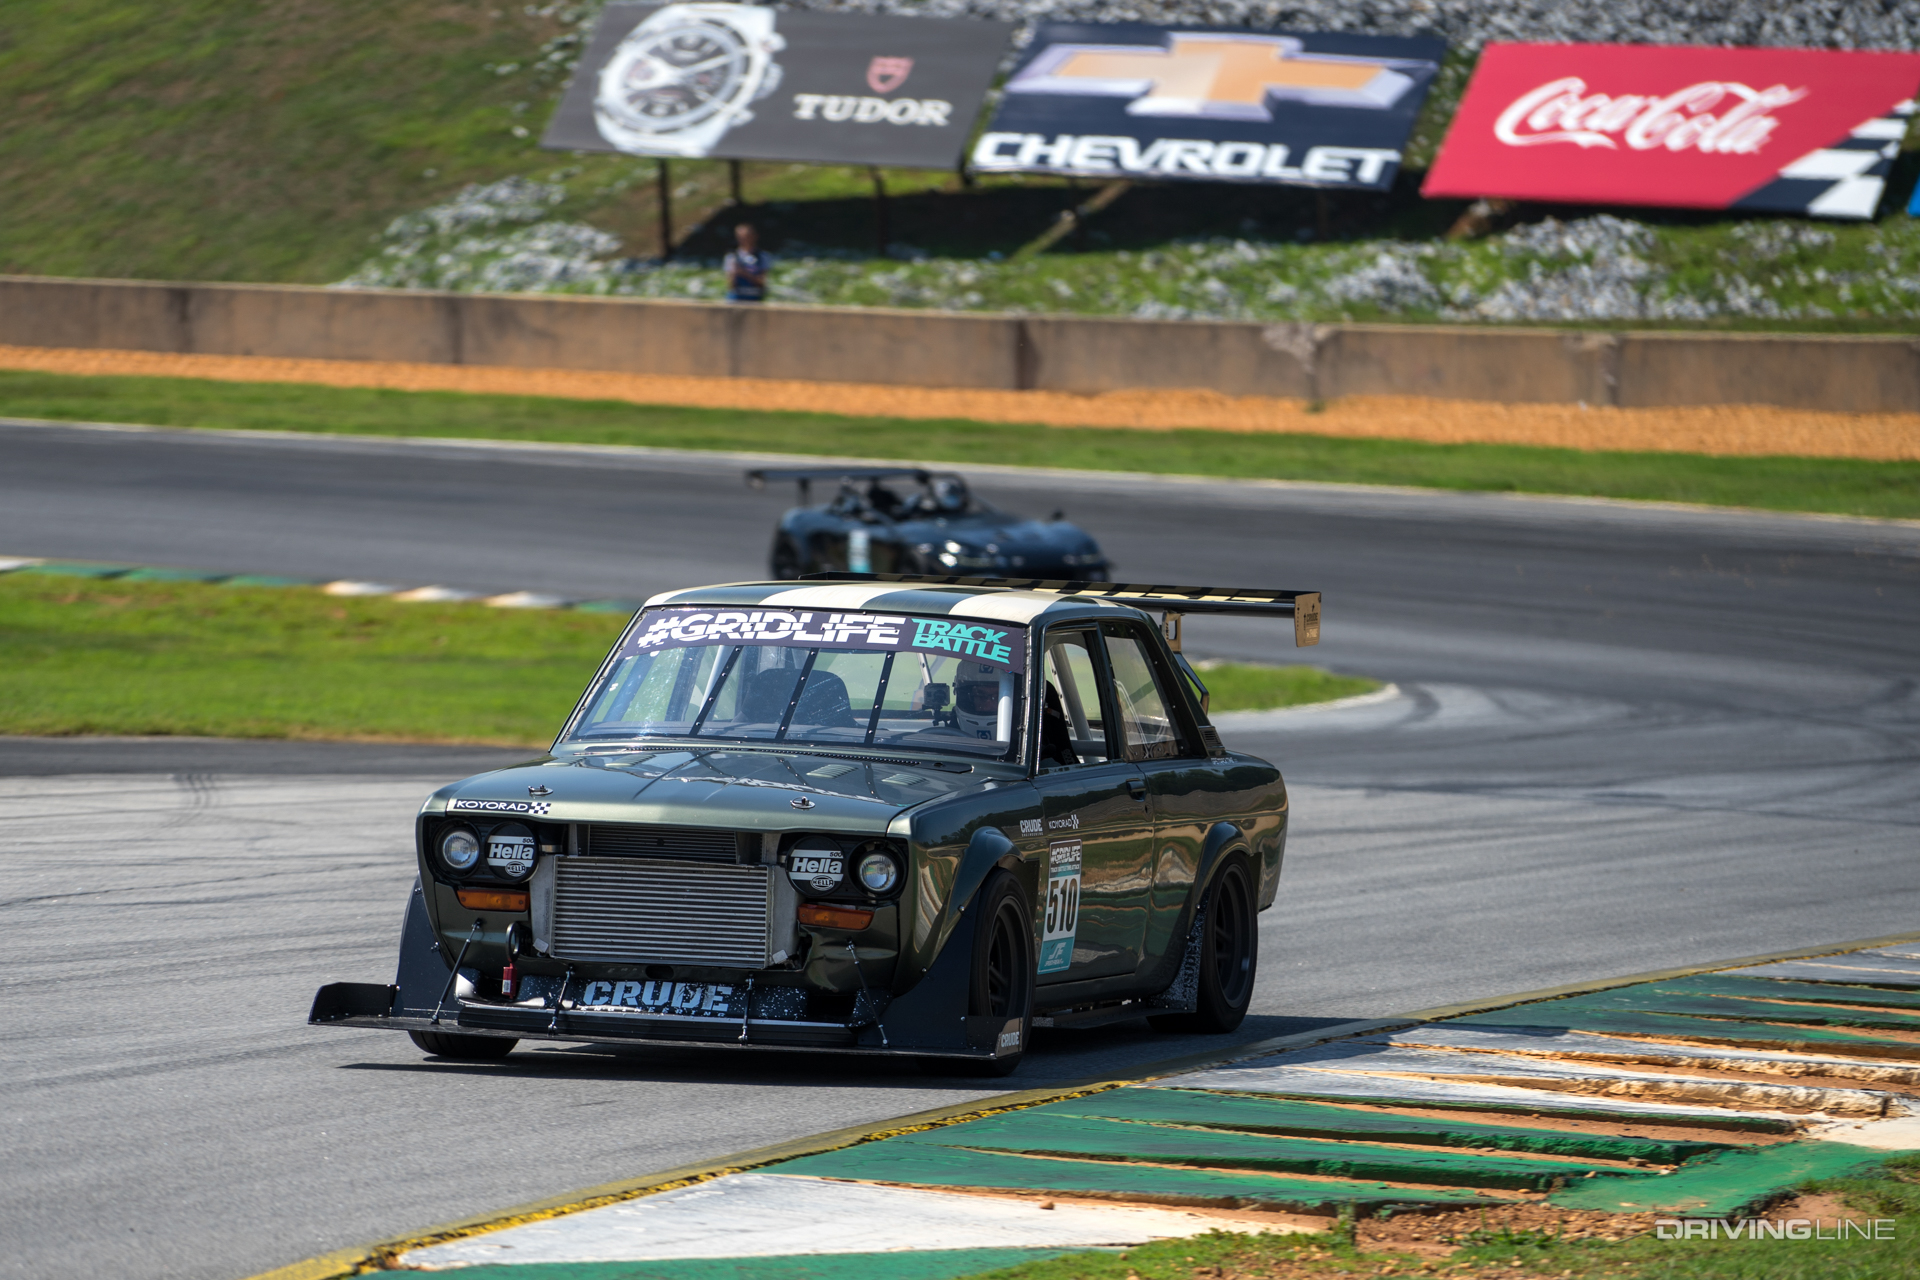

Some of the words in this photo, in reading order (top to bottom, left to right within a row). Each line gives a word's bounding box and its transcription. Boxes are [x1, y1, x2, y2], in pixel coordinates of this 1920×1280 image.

[793, 94, 953, 126] TUDOR
[973, 132, 1401, 183] CHEVROLET
[637, 611, 907, 648] #GRIDLIFE
[911, 618, 1009, 643] TRACK
[912, 633, 1012, 664] BATTLE
[456, 800, 529, 812] KOYORAD
[1020, 818, 1043, 833] CRUDE
[1048, 818, 1073, 830] KOYORAD
[488, 843, 535, 860] Hella
[791, 857, 843, 874] Hella
[1047, 878, 1078, 934] 510
[583, 981, 733, 1012] CRUDE
[580, 1006, 726, 1017] ENGINEERING
[1001, 1031, 1020, 1048] CRUDE
